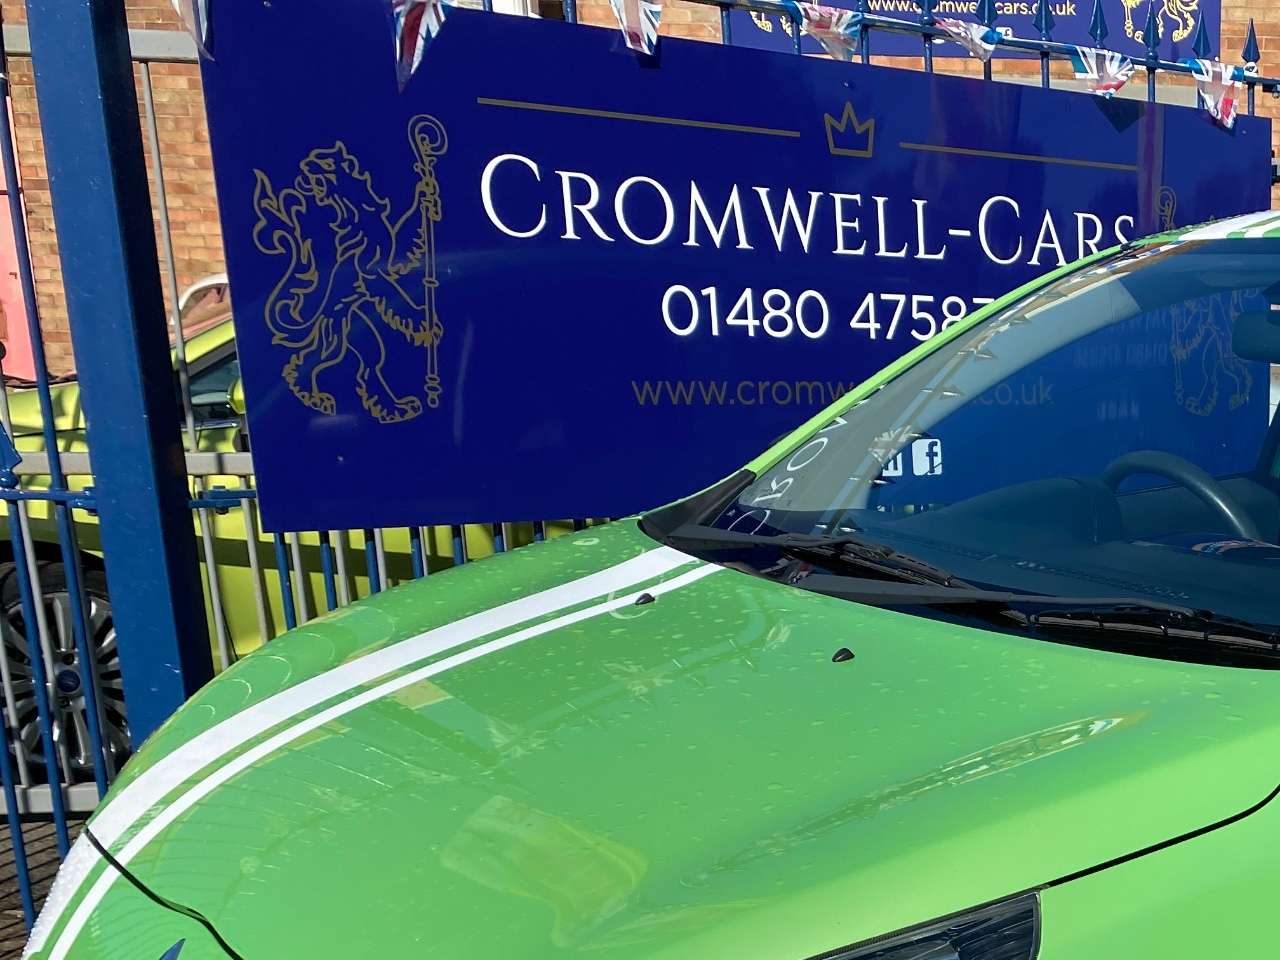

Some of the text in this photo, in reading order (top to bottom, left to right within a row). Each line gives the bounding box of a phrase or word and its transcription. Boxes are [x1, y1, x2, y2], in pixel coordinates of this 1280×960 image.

[481, 152, 1135, 266] CROMWELL-CARS
[661, 285, 995, 341] 01480 4758
